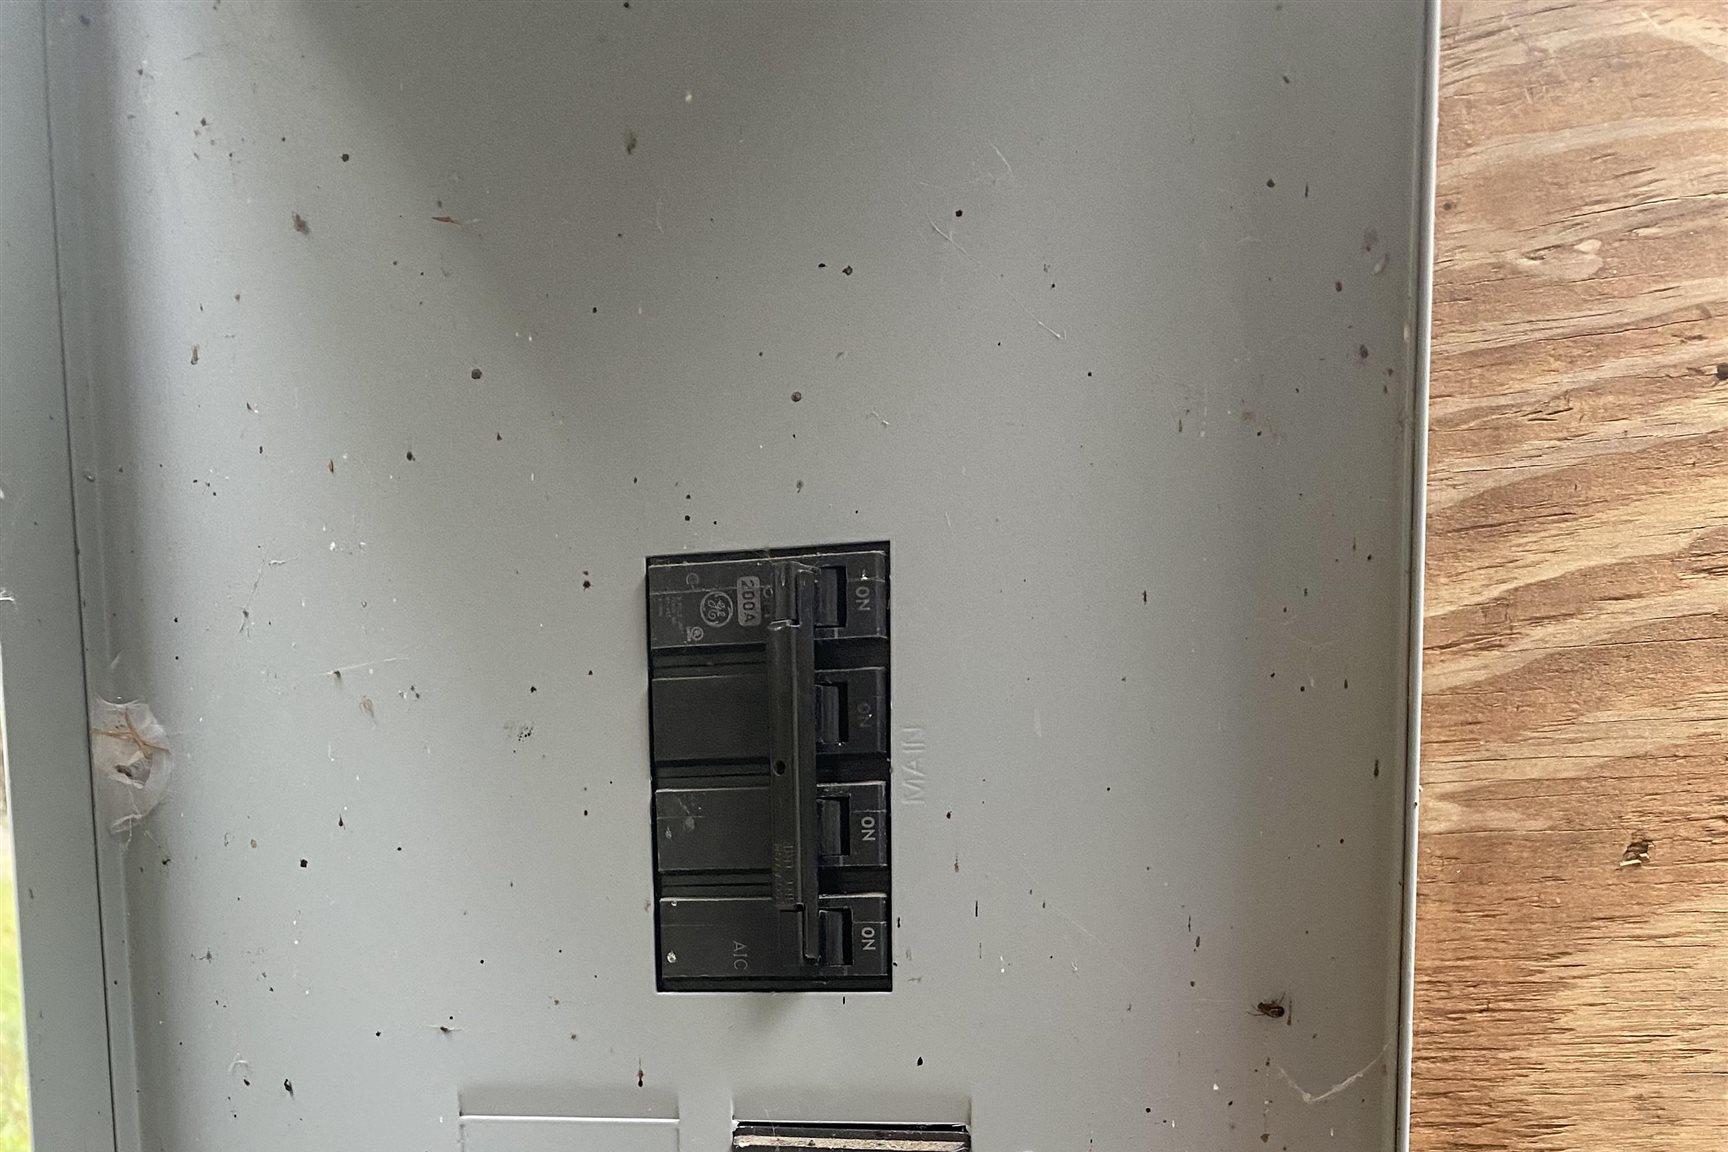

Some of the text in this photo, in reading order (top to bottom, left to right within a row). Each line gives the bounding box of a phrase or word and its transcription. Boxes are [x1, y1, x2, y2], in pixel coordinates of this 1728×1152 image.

[740, 579, 757, 623] 200A
[855, 585, 871, 611] ON
[902, 726, 927, 806] MAIN
[860, 816, 876, 841] ON
[861, 927, 876, 951] ON
[733, 940, 748, 970] AIC
